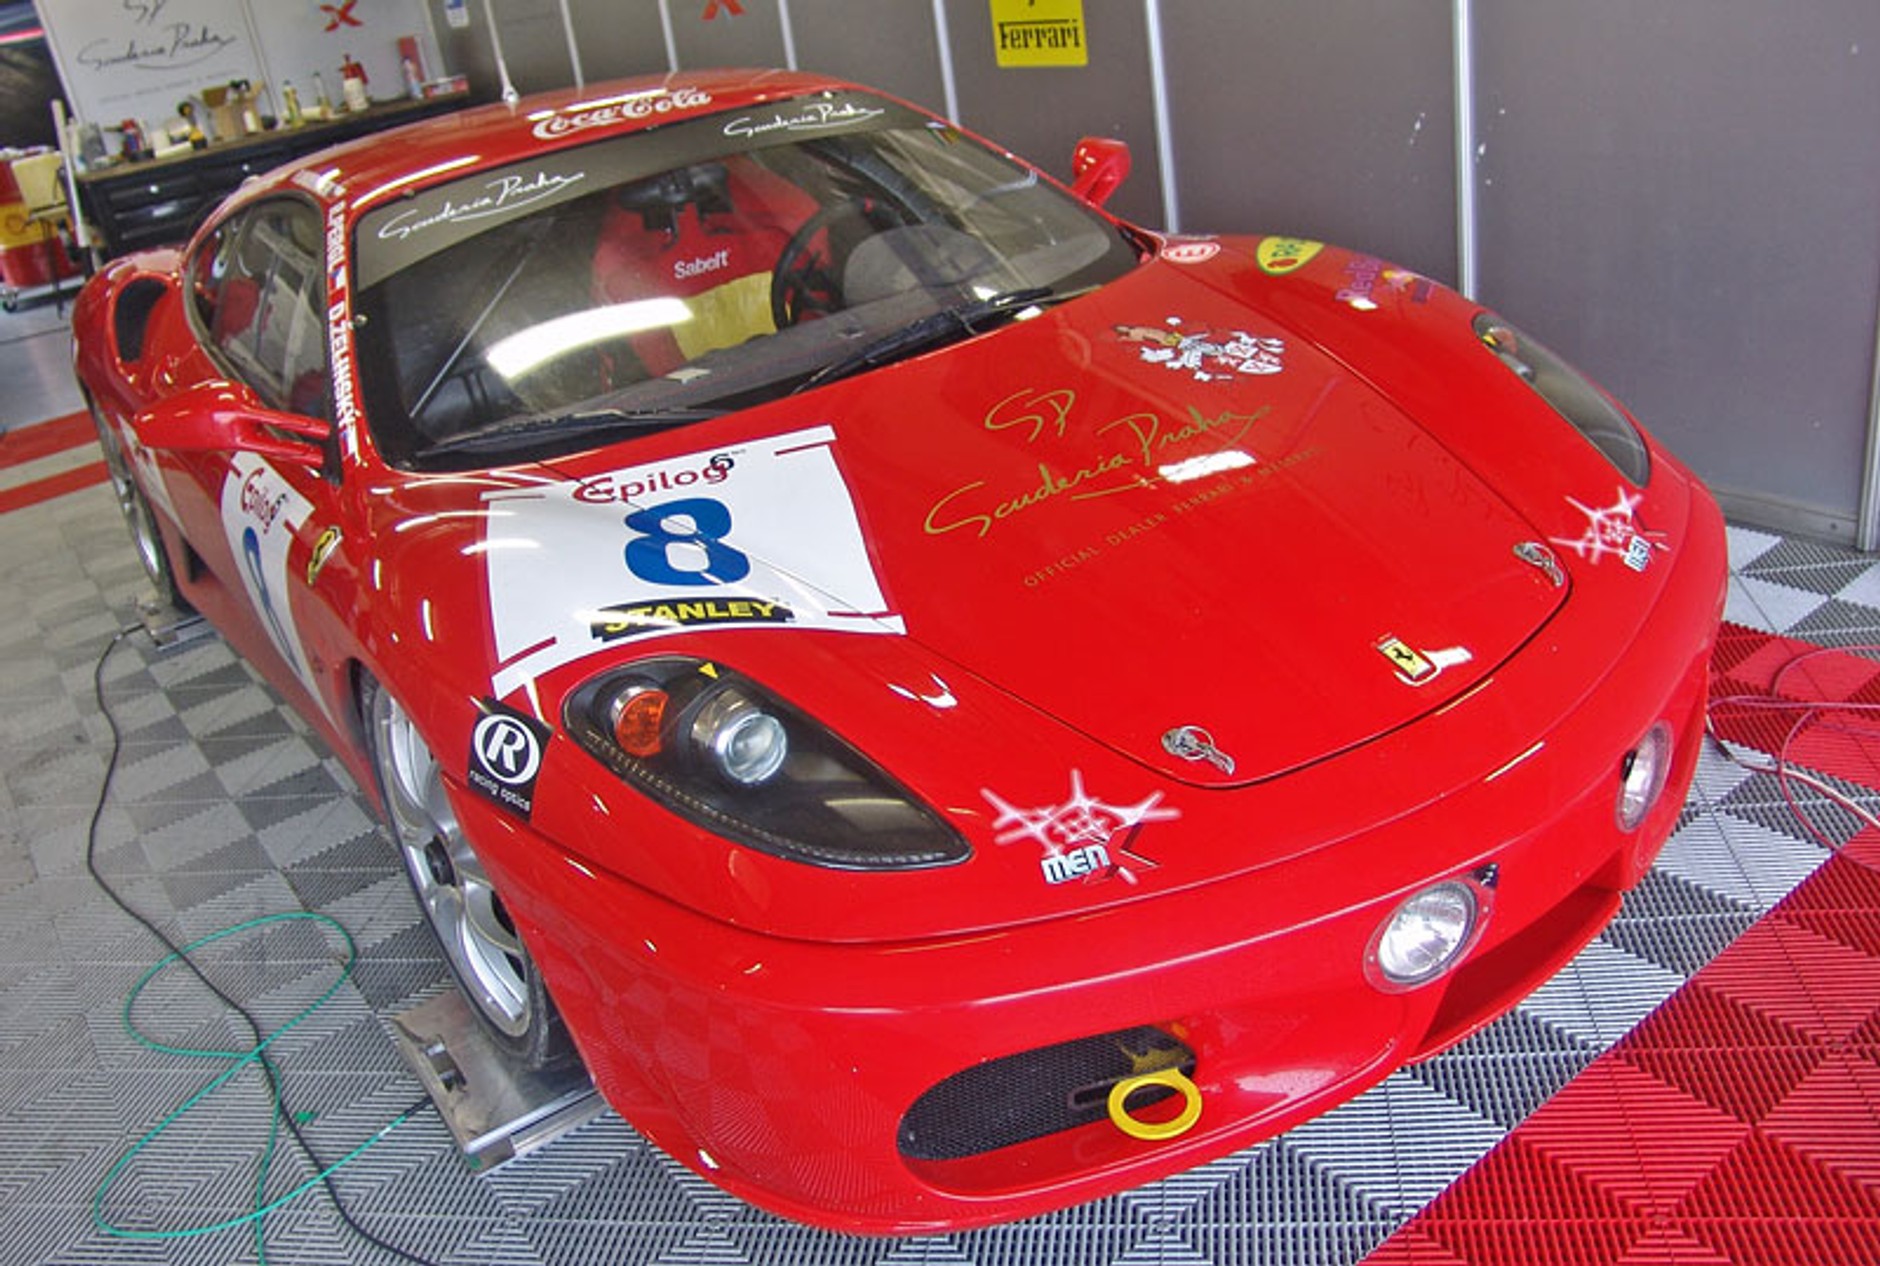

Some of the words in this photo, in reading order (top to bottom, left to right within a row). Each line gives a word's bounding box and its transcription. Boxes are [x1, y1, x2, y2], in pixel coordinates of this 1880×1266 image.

[998, 19, 1080, 49] Ferrari
[674, 250, 728, 278] Sabelt
[985, 388, 1075, 442] SP
[572, 463, 728, 505] Epilog
[924, 455, 1132, 537] Scuderia
[1097, 405, 1272, 466] Praha
[624, 497, 751, 587] 8
[1024, 546, 1100, 588] OFFICIAL
[1106, 513, 1168, 547] DEALER
[470, 770, 500, 796] racing
